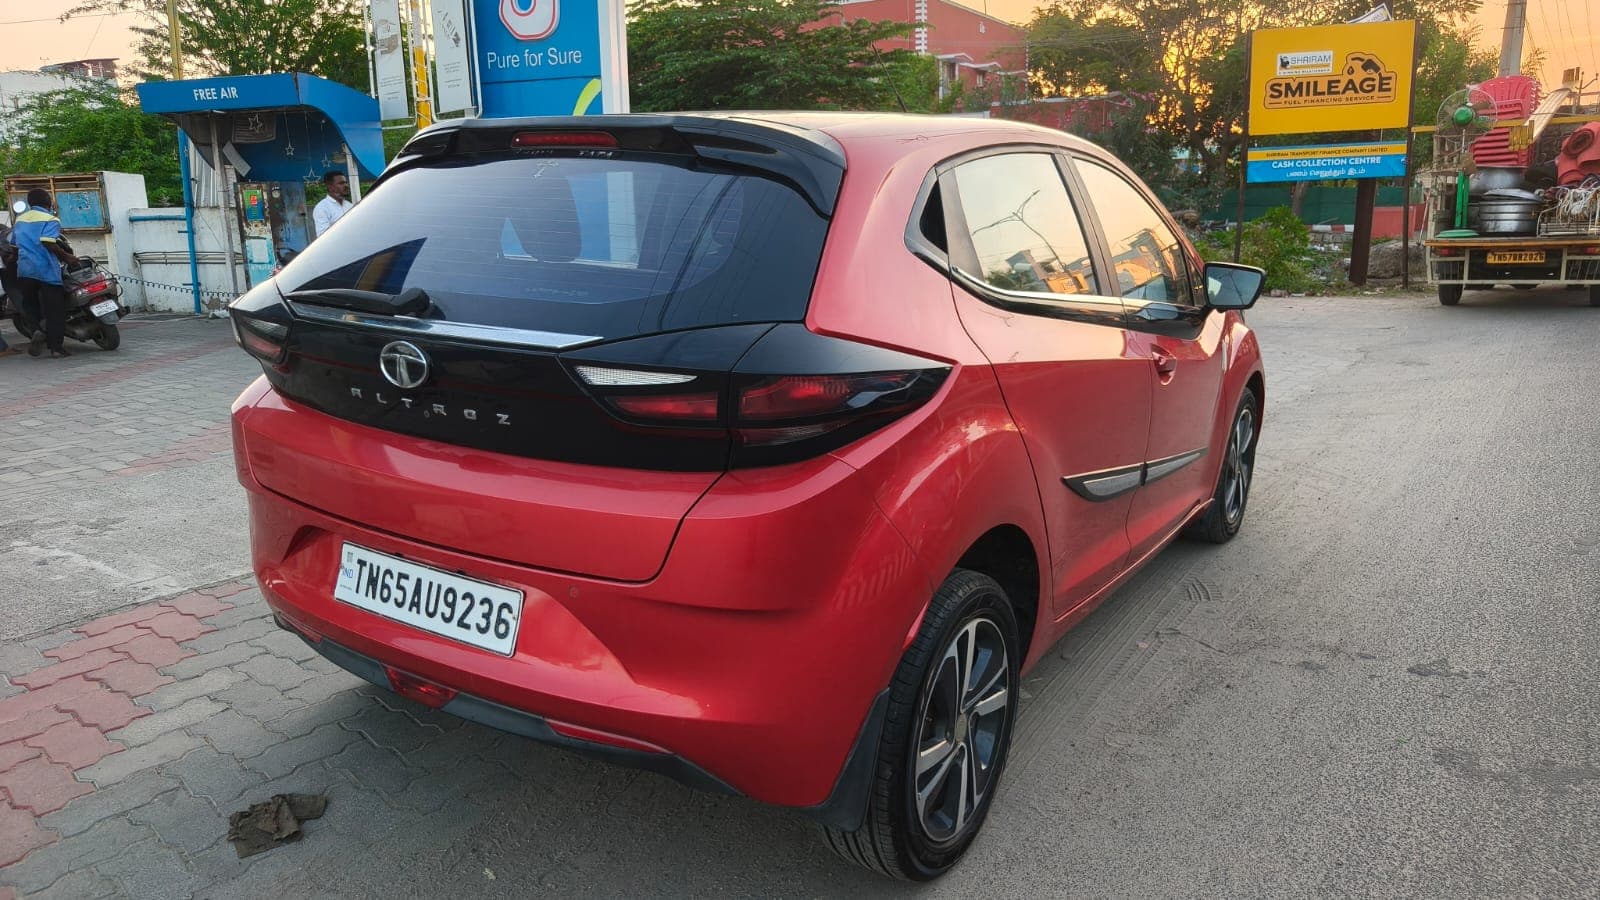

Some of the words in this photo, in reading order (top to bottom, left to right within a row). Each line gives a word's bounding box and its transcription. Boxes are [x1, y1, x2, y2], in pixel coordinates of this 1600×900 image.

[487, 52, 521, 70] Pure
[523, 49, 543, 66] for
[547, 47, 582, 66] Sure
[1290, 54, 1331, 65] SHRIRAM
[193, 87, 218, 101] FREE
[220, 86, 239, 99] AIR
[1268, 76, 1392, 99] SMILEAGE
[1272, 161, 1294, 169] CASH
[1295, 158, 1347, 168] COLLECTION
[1348, 156, 1382, 165] CENTRE
[351, 387, 511, 425] ALTROZ
[355, 558, 514, 640] TN65AU9236
